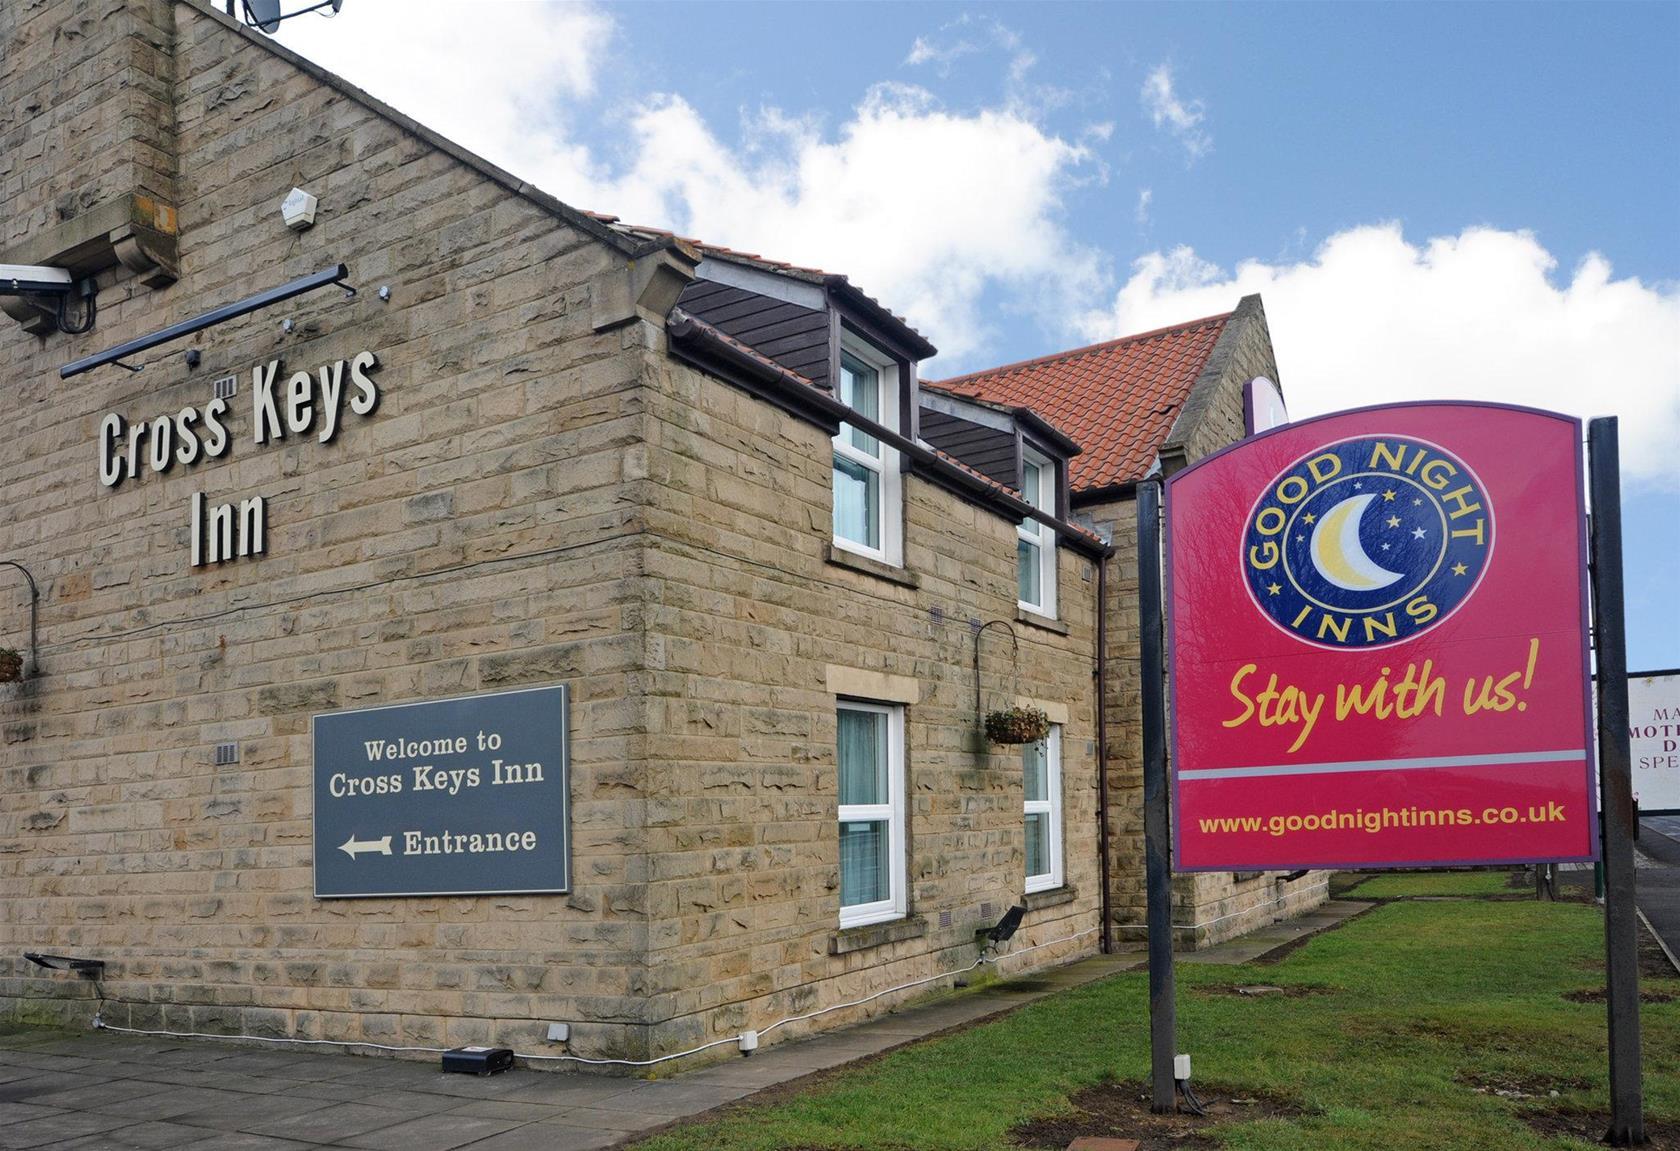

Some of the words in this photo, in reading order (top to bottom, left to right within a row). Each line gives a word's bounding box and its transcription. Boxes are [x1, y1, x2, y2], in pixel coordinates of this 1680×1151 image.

[100, 399, 226, 486] Cross
[253, 351, 376, 443] Keys
[1250, 453, 1342, 570] GOOD
[1369, 442, 1484, 545] NIGHT
[191, 492, 266, 566] Inn
[1291, 596, 1438, 642] INNS
[1222, 664, 1325, 753] Stay
[1336, 659, 1446, 721] with
[1464, 638, 1540, 715] us!
[364, 738, 467, 761] Welcome
[476, 730, 501, 751] to
[1629, 724, 1680, 739] MOT
[329, 772, 402, 797] Cross
[412, 765, 480, 795] Keys
[491, 759, 544, 785] Inn
[1199, 801, 1566, 837] www.goodnightinns.co.uk
[403, 830, 537, 855] Entrance
